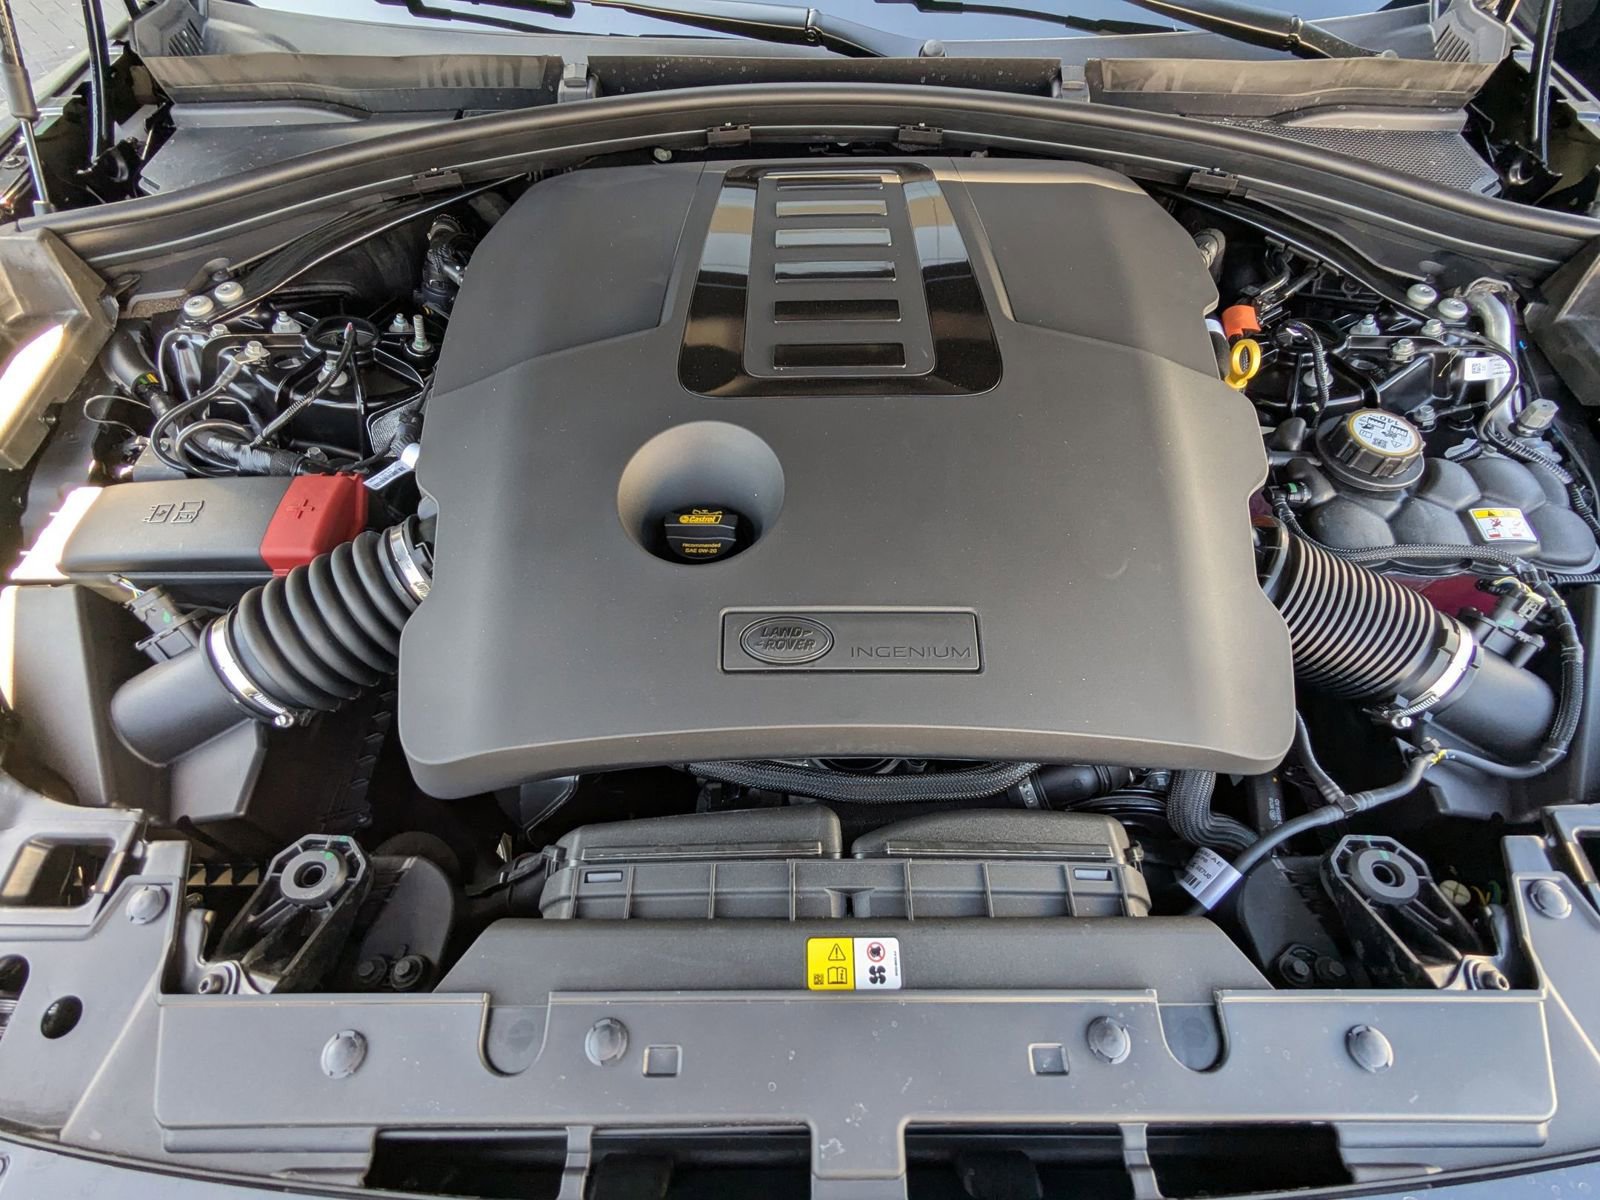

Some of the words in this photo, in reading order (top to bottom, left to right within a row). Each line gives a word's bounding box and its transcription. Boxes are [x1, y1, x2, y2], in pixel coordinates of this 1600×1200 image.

[689, 515, 715, 523] Castrol
[761, 626, 802, 638] LAND
[763, 638, 816, 650] ROVER
[850, 646, 972, 658] INGENIUM
